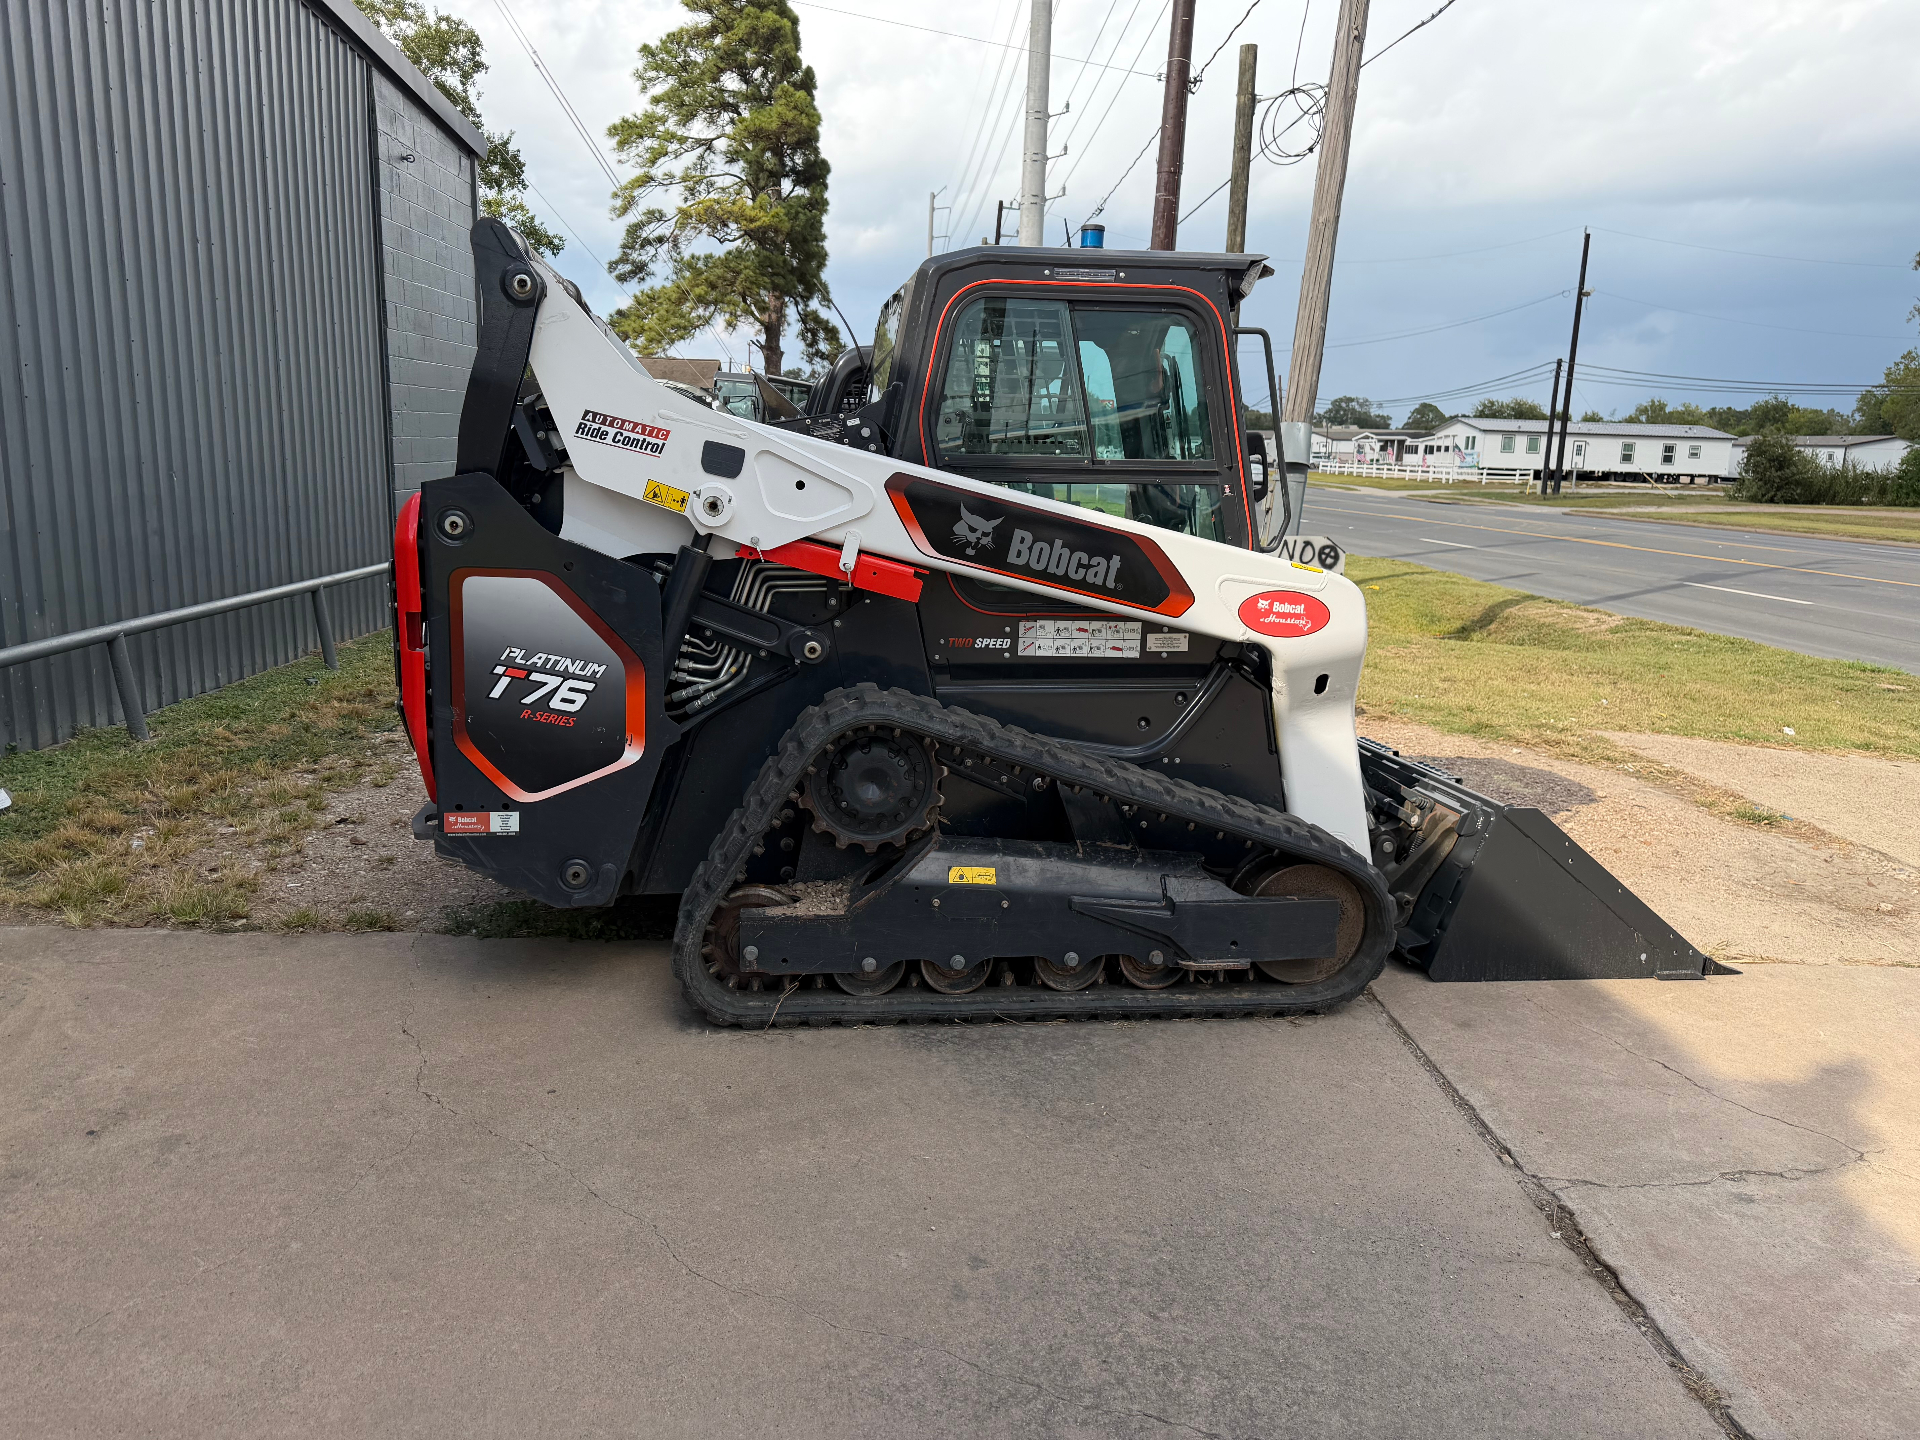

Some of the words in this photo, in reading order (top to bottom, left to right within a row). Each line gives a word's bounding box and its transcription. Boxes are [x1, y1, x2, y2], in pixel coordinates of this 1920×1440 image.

[574, 421, 609, 441] Ride
[611, 430, 667, 455] Control
[584, 411, 668, 440] AUTOMATIC
[1006, 528, 1122, 589] Bobcat
[1264, 613, 1307, 625] Houston
[1272, 601, 1305, 614] Bobcat
[948, 637, 973, 649] TWO
[974, 637, 1011, 649] SPEED
[499, 645, 609, 679] PLATINUM
[487, 664, 597, 713] T76
[520, 709, 577, 727] R-SERIES
